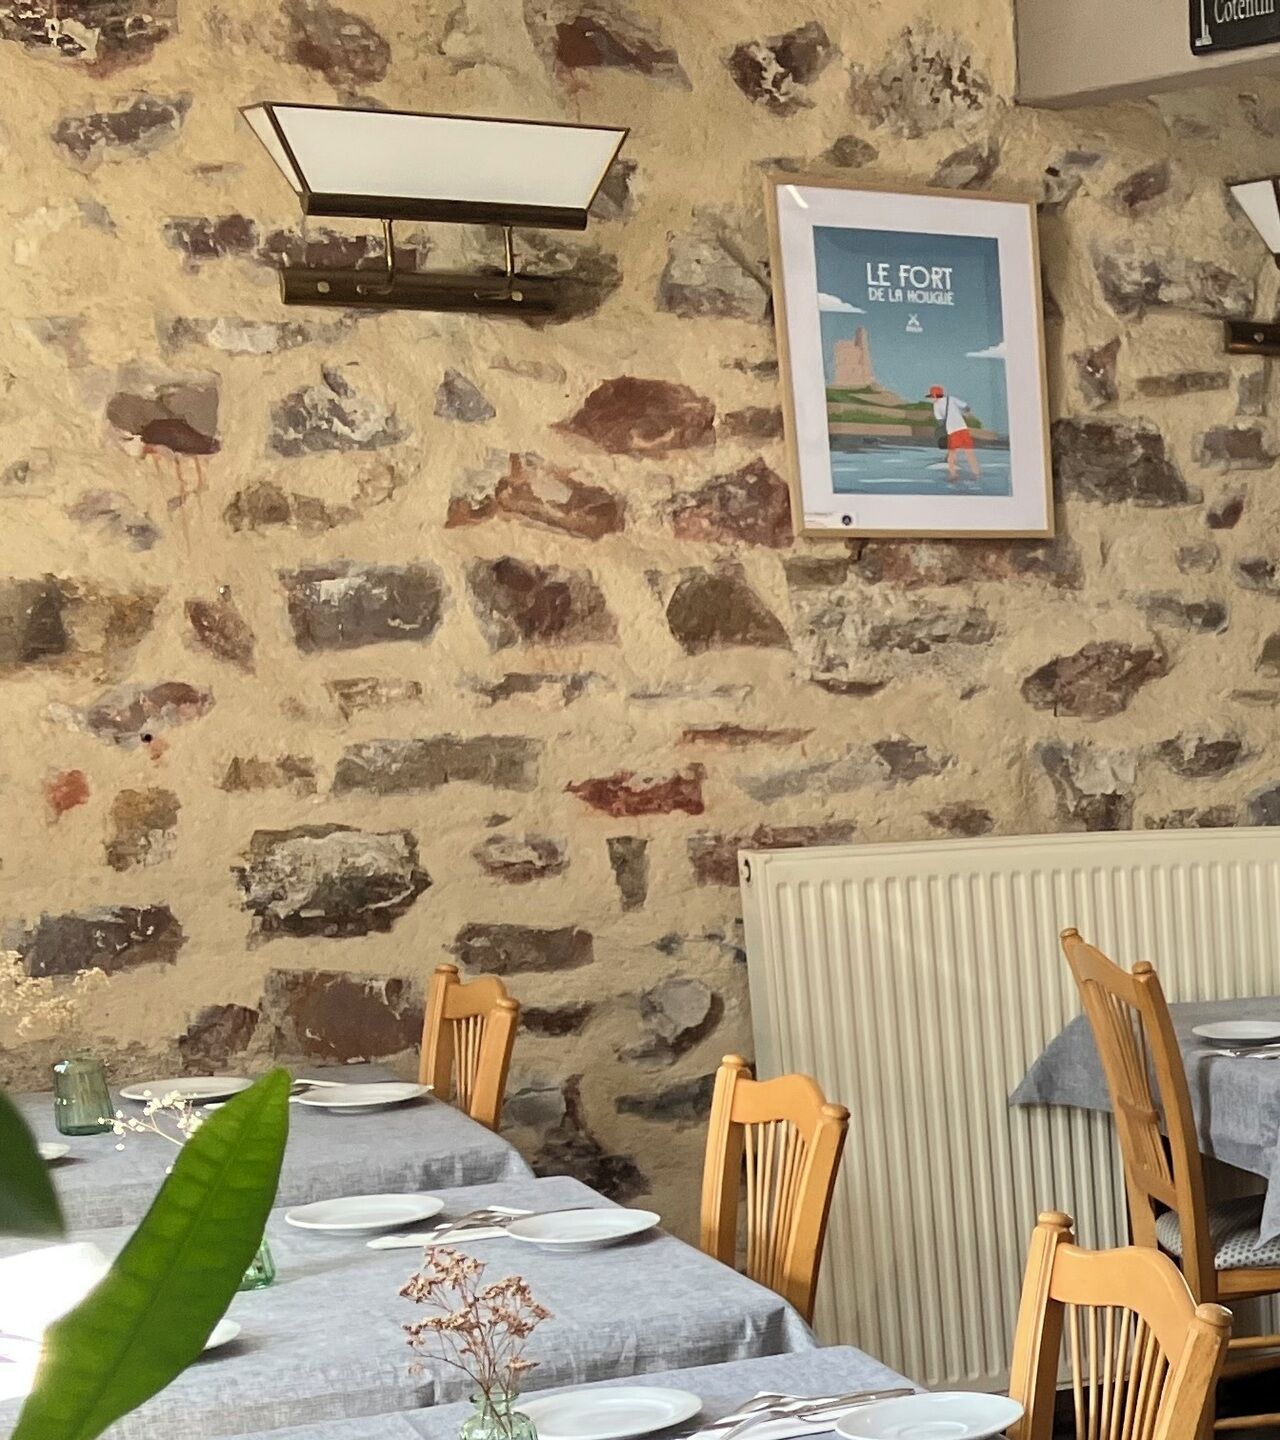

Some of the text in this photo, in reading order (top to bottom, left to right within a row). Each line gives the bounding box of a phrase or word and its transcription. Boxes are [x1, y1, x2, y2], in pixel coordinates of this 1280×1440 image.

[866, 262, 952, 290] LE FORT
[868, 287, 955, 306] DE LA HOUGUE
